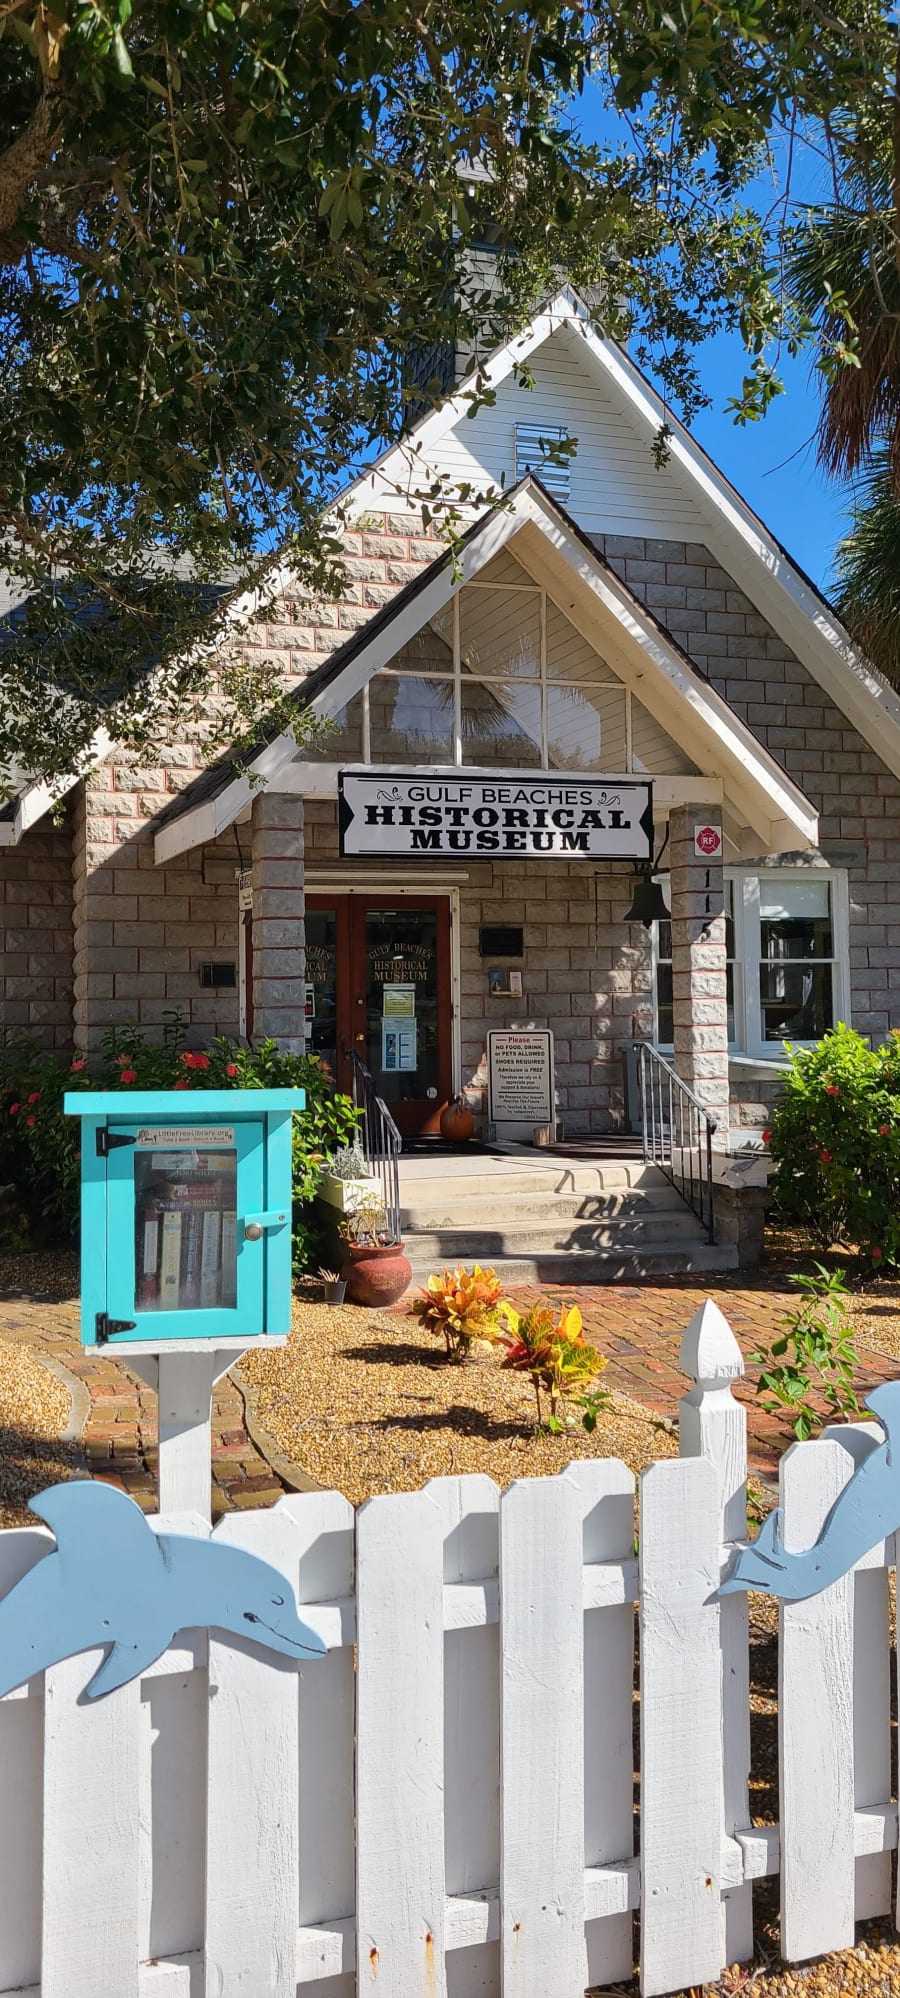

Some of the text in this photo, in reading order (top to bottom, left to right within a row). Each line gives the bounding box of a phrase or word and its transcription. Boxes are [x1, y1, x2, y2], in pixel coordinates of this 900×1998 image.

[407, 786, 593, 806] GULF BEACHES
[363, 804, 632, 830] HISTORICAL
[409, 829, 591, 851] MUSEUM
[702, 836, 714, 846] RF
[305, 945, 331, 960] ACHES
[368, 943, 433, 960] GULF BEACHES
[374, 960, 428, 970] HISTORICAL
[374, 971, 428, 981] MUSEUM
[158, 1127, 229, 1138] LittleFreeLibrary.org
